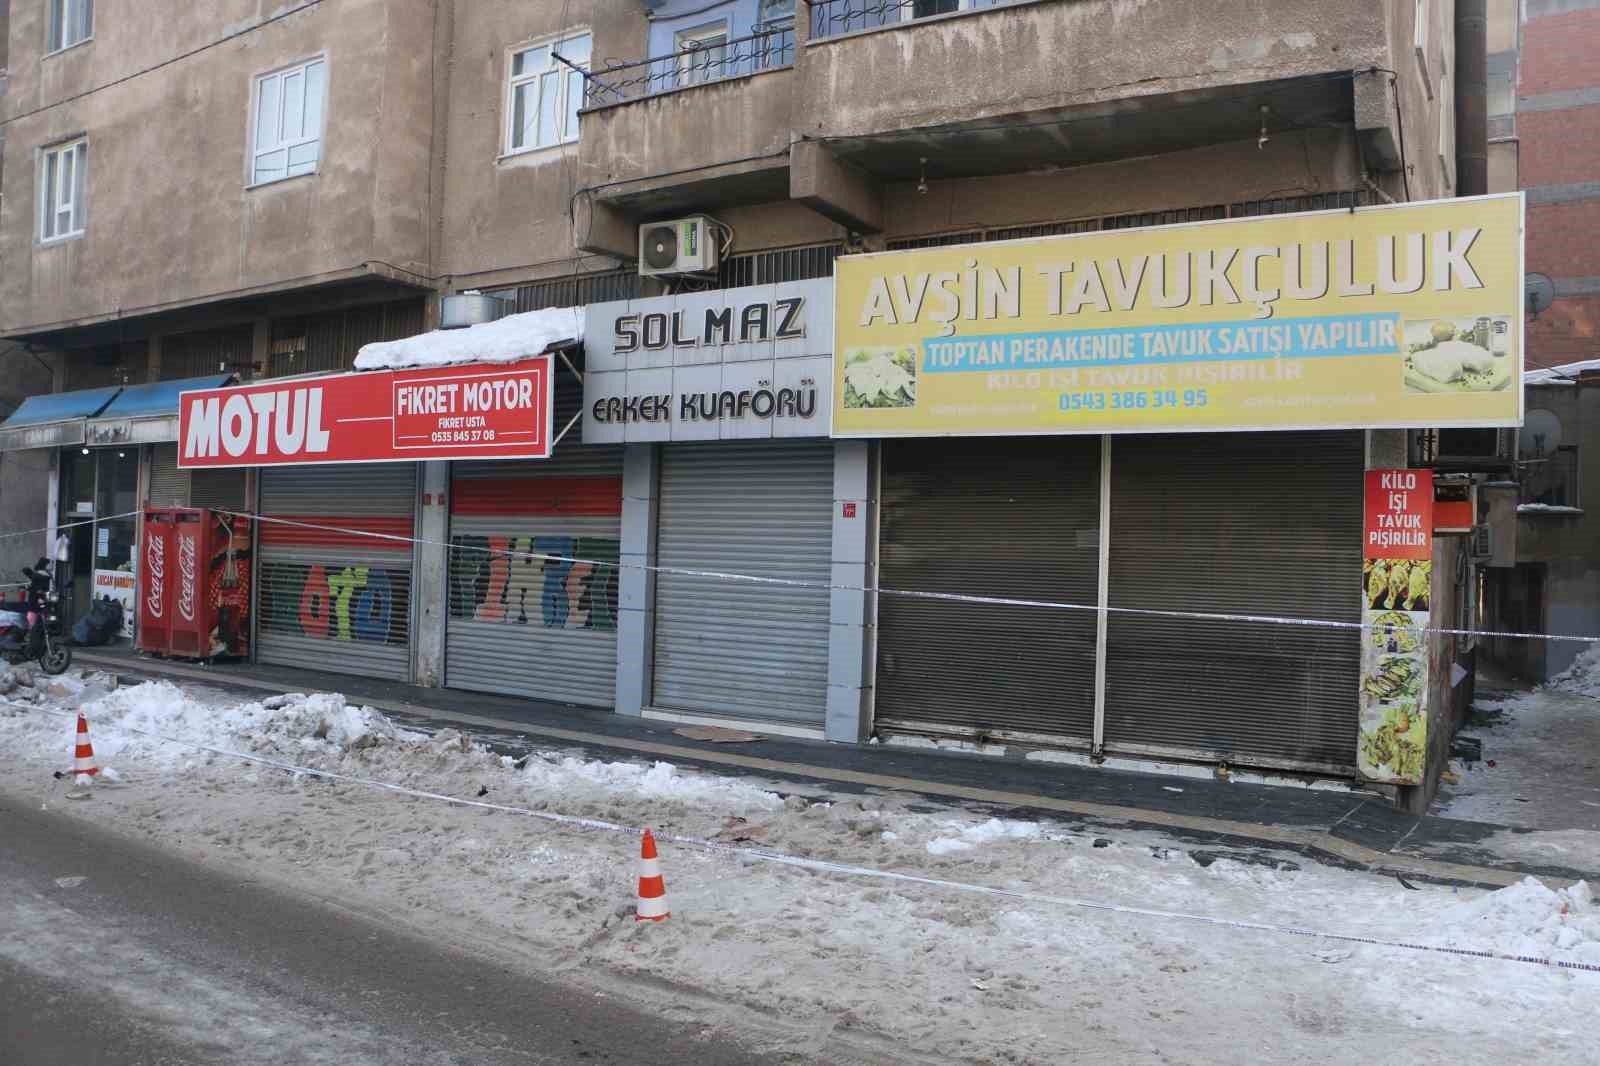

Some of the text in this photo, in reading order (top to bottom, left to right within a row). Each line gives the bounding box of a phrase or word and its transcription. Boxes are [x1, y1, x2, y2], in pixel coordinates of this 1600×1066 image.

[858, 228, 1486, 338] AVŞİN TAVUKÇULUK
[614, 297, 806, 354] SOLMAZ
[928, 319, 1395, 367] TOPTAN PERAKENDE TAVUK SATIŞI YAPILIR
[463, 378, 533, 412] MOTOR
[592, 377, 817, 424] ERKEK KUAFÖRÜ
[1059, 391, 1105, 410] 0543
[1110, 391, 1148, 409] 386
[1152, 389, 1177, 408] 34
[1184, 388, 1208, 407] 95
[184, 387, 330, 458] MOTUL
[431, 431, 452, 442] 0535
[471, 430, 482, 441] 37
[465, 415, 486, 428] USTA
[1381, 470, 1416, 490] KİLO
[1377, 514, 1421, 529] TAVUK
